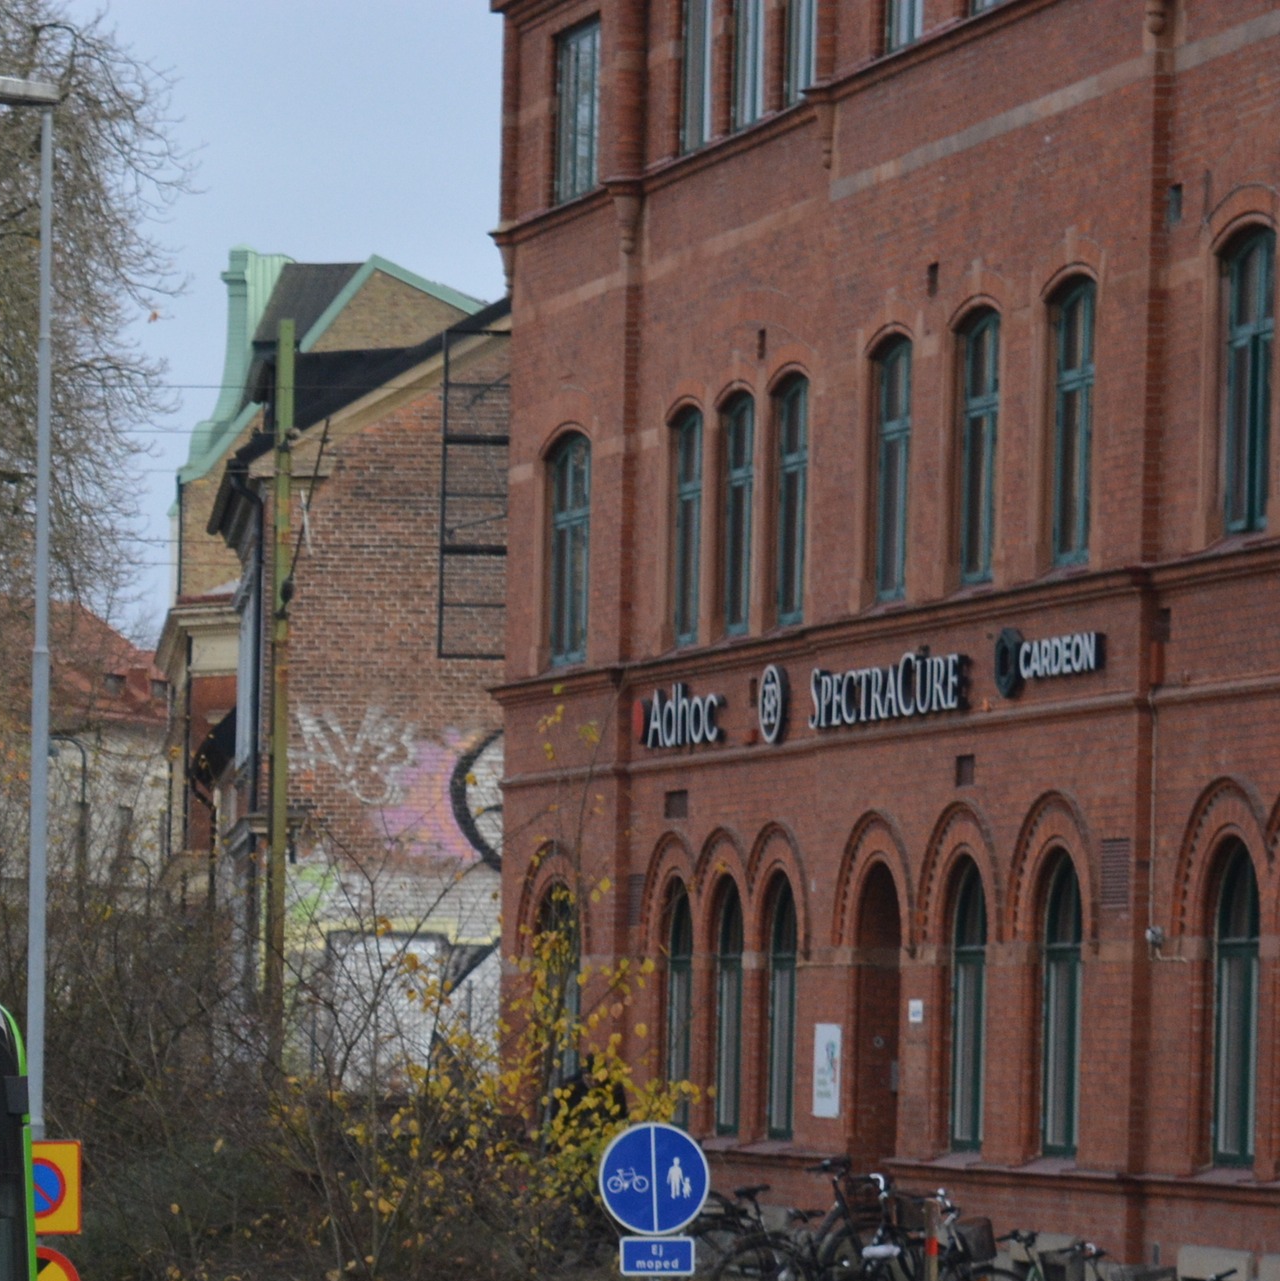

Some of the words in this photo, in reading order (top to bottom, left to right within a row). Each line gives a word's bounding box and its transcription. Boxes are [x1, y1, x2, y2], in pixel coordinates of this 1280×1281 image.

[1019, 632, 1096, 680] CARDEON
[647, 682, 718, 748] Adhoc
[635, 1258, 680, 1271] moped
[651, 1244, 663, 1258] Ej
